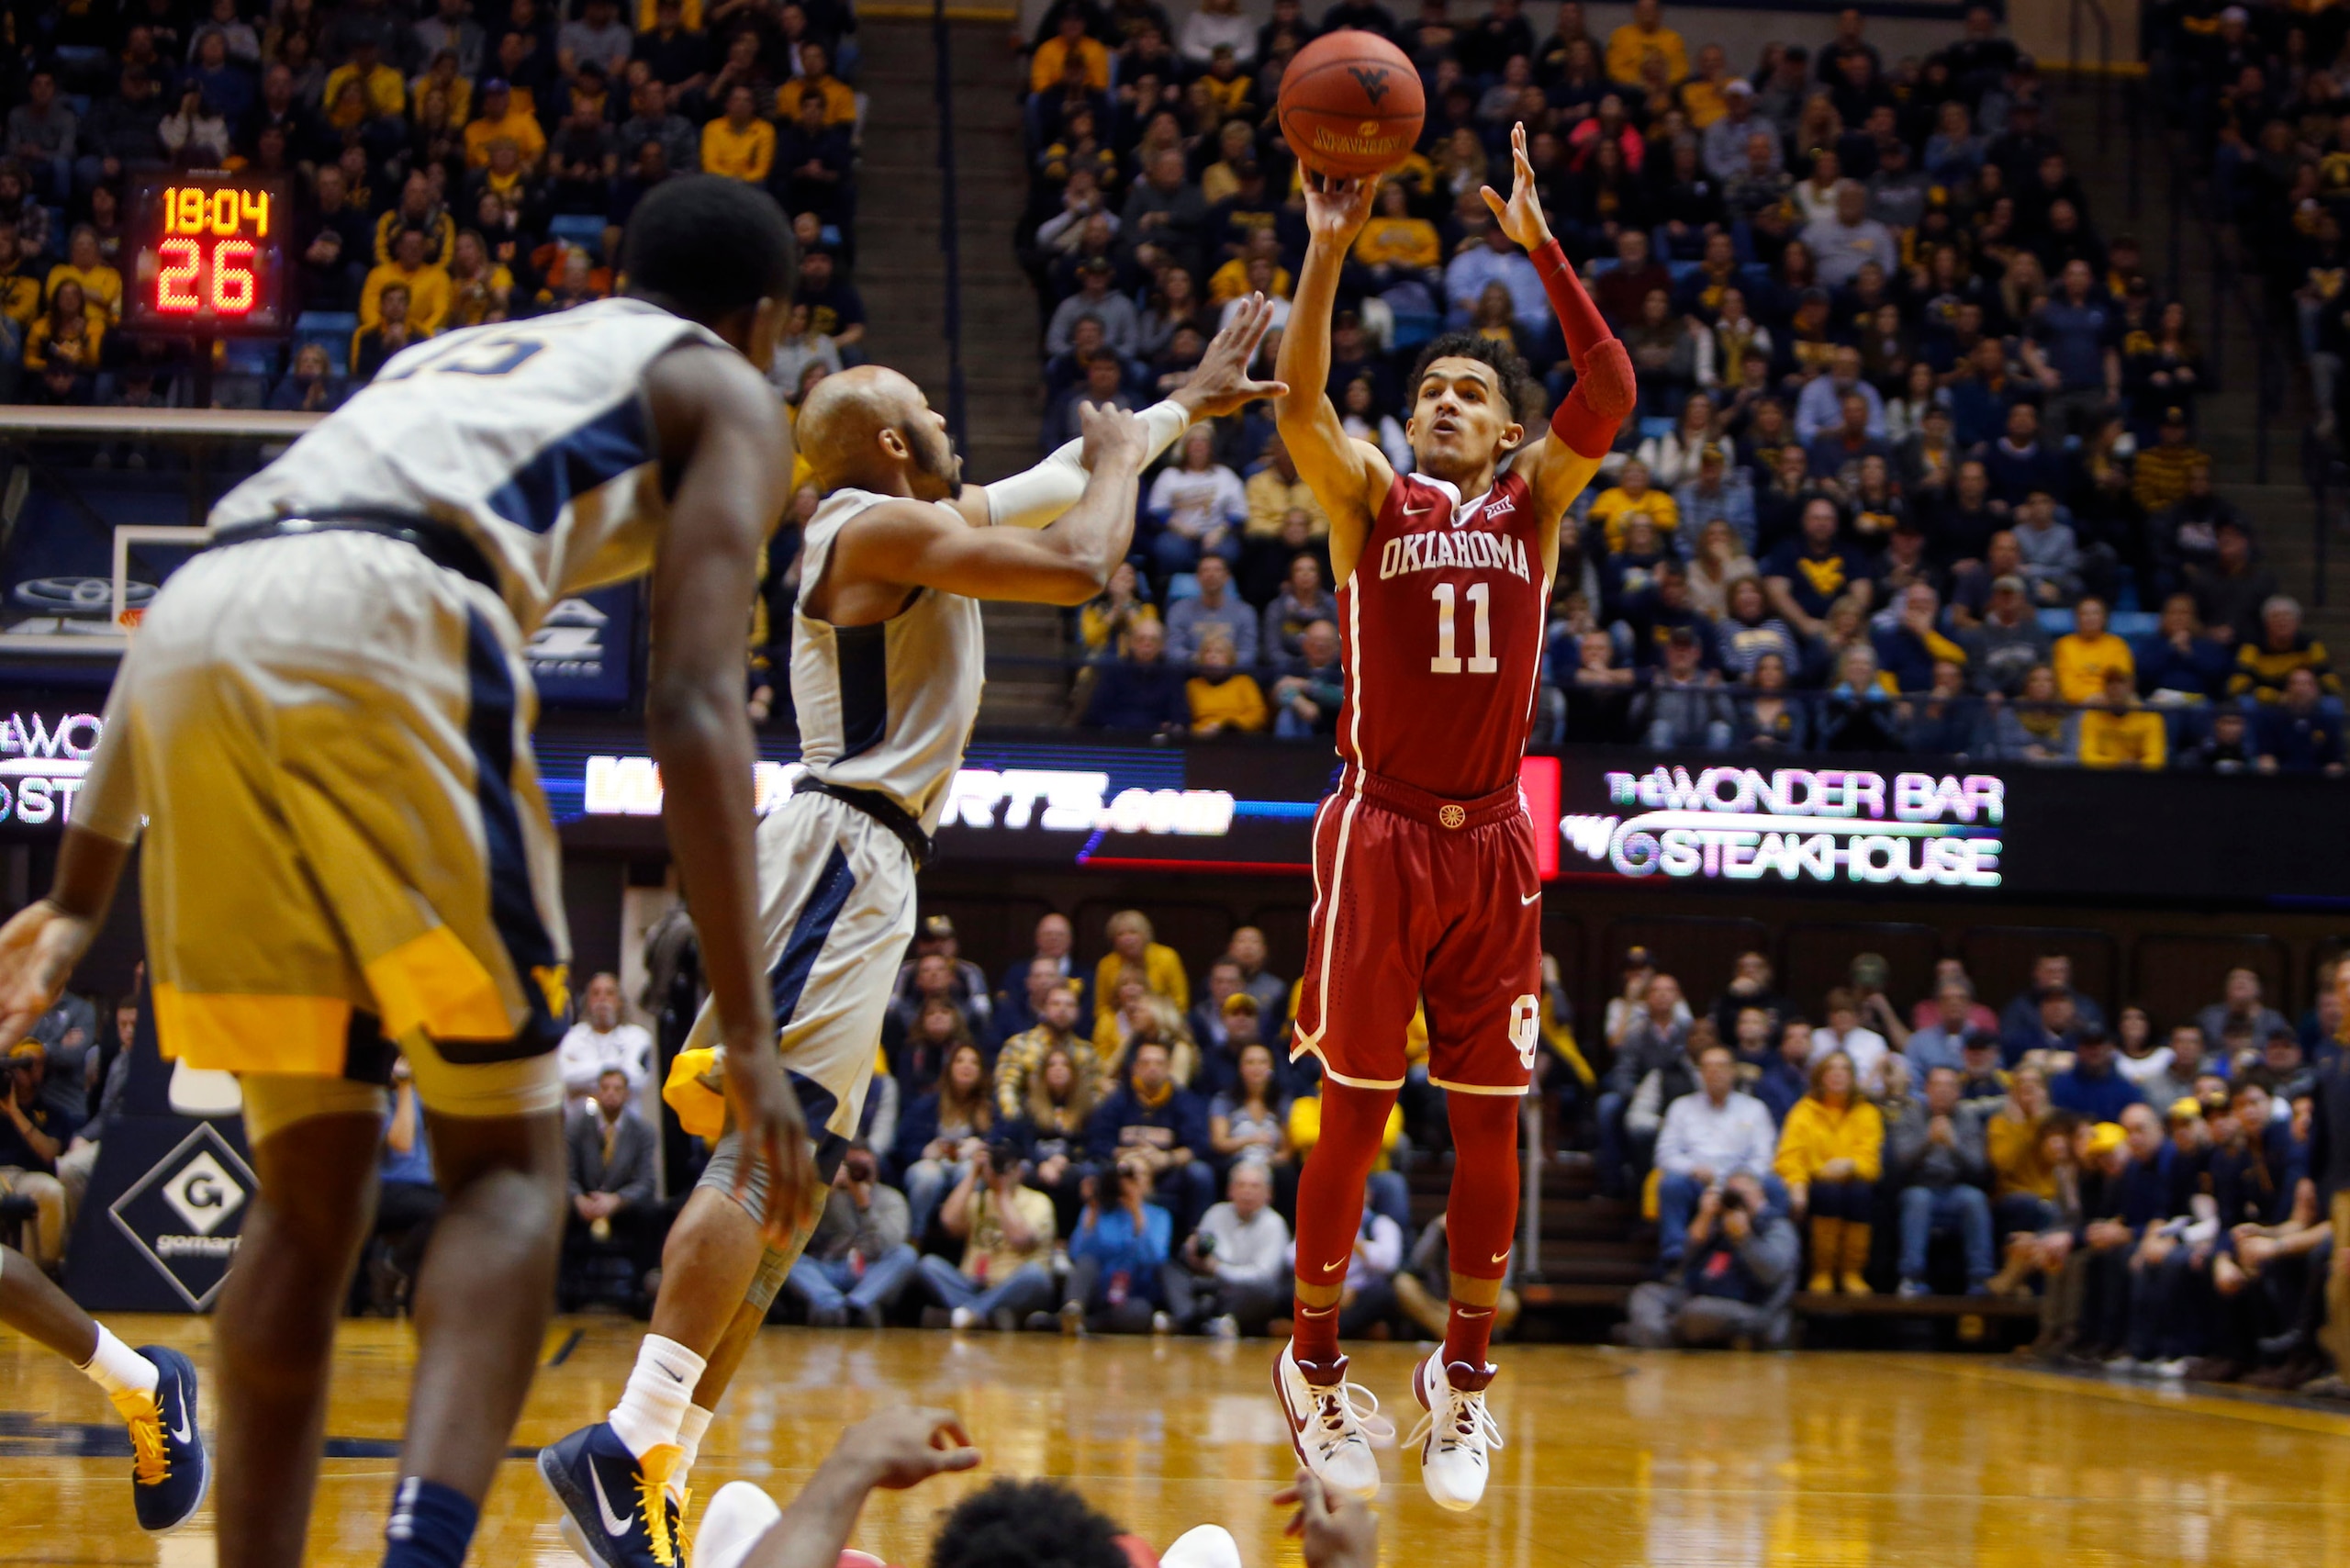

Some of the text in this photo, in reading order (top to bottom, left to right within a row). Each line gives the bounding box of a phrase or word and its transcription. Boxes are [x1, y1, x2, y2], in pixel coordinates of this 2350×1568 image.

[157, 238, 255, 313] 26
[1379, 530, 1531, 585] OKLAHOMA
[1430, 582, 1498, 674] 11
[1655, 764, 1886, 818] WONDER
[1894, 772, 2006, 825] BAR
[1659, 828, 2004, 888] STEAKHOUSE
